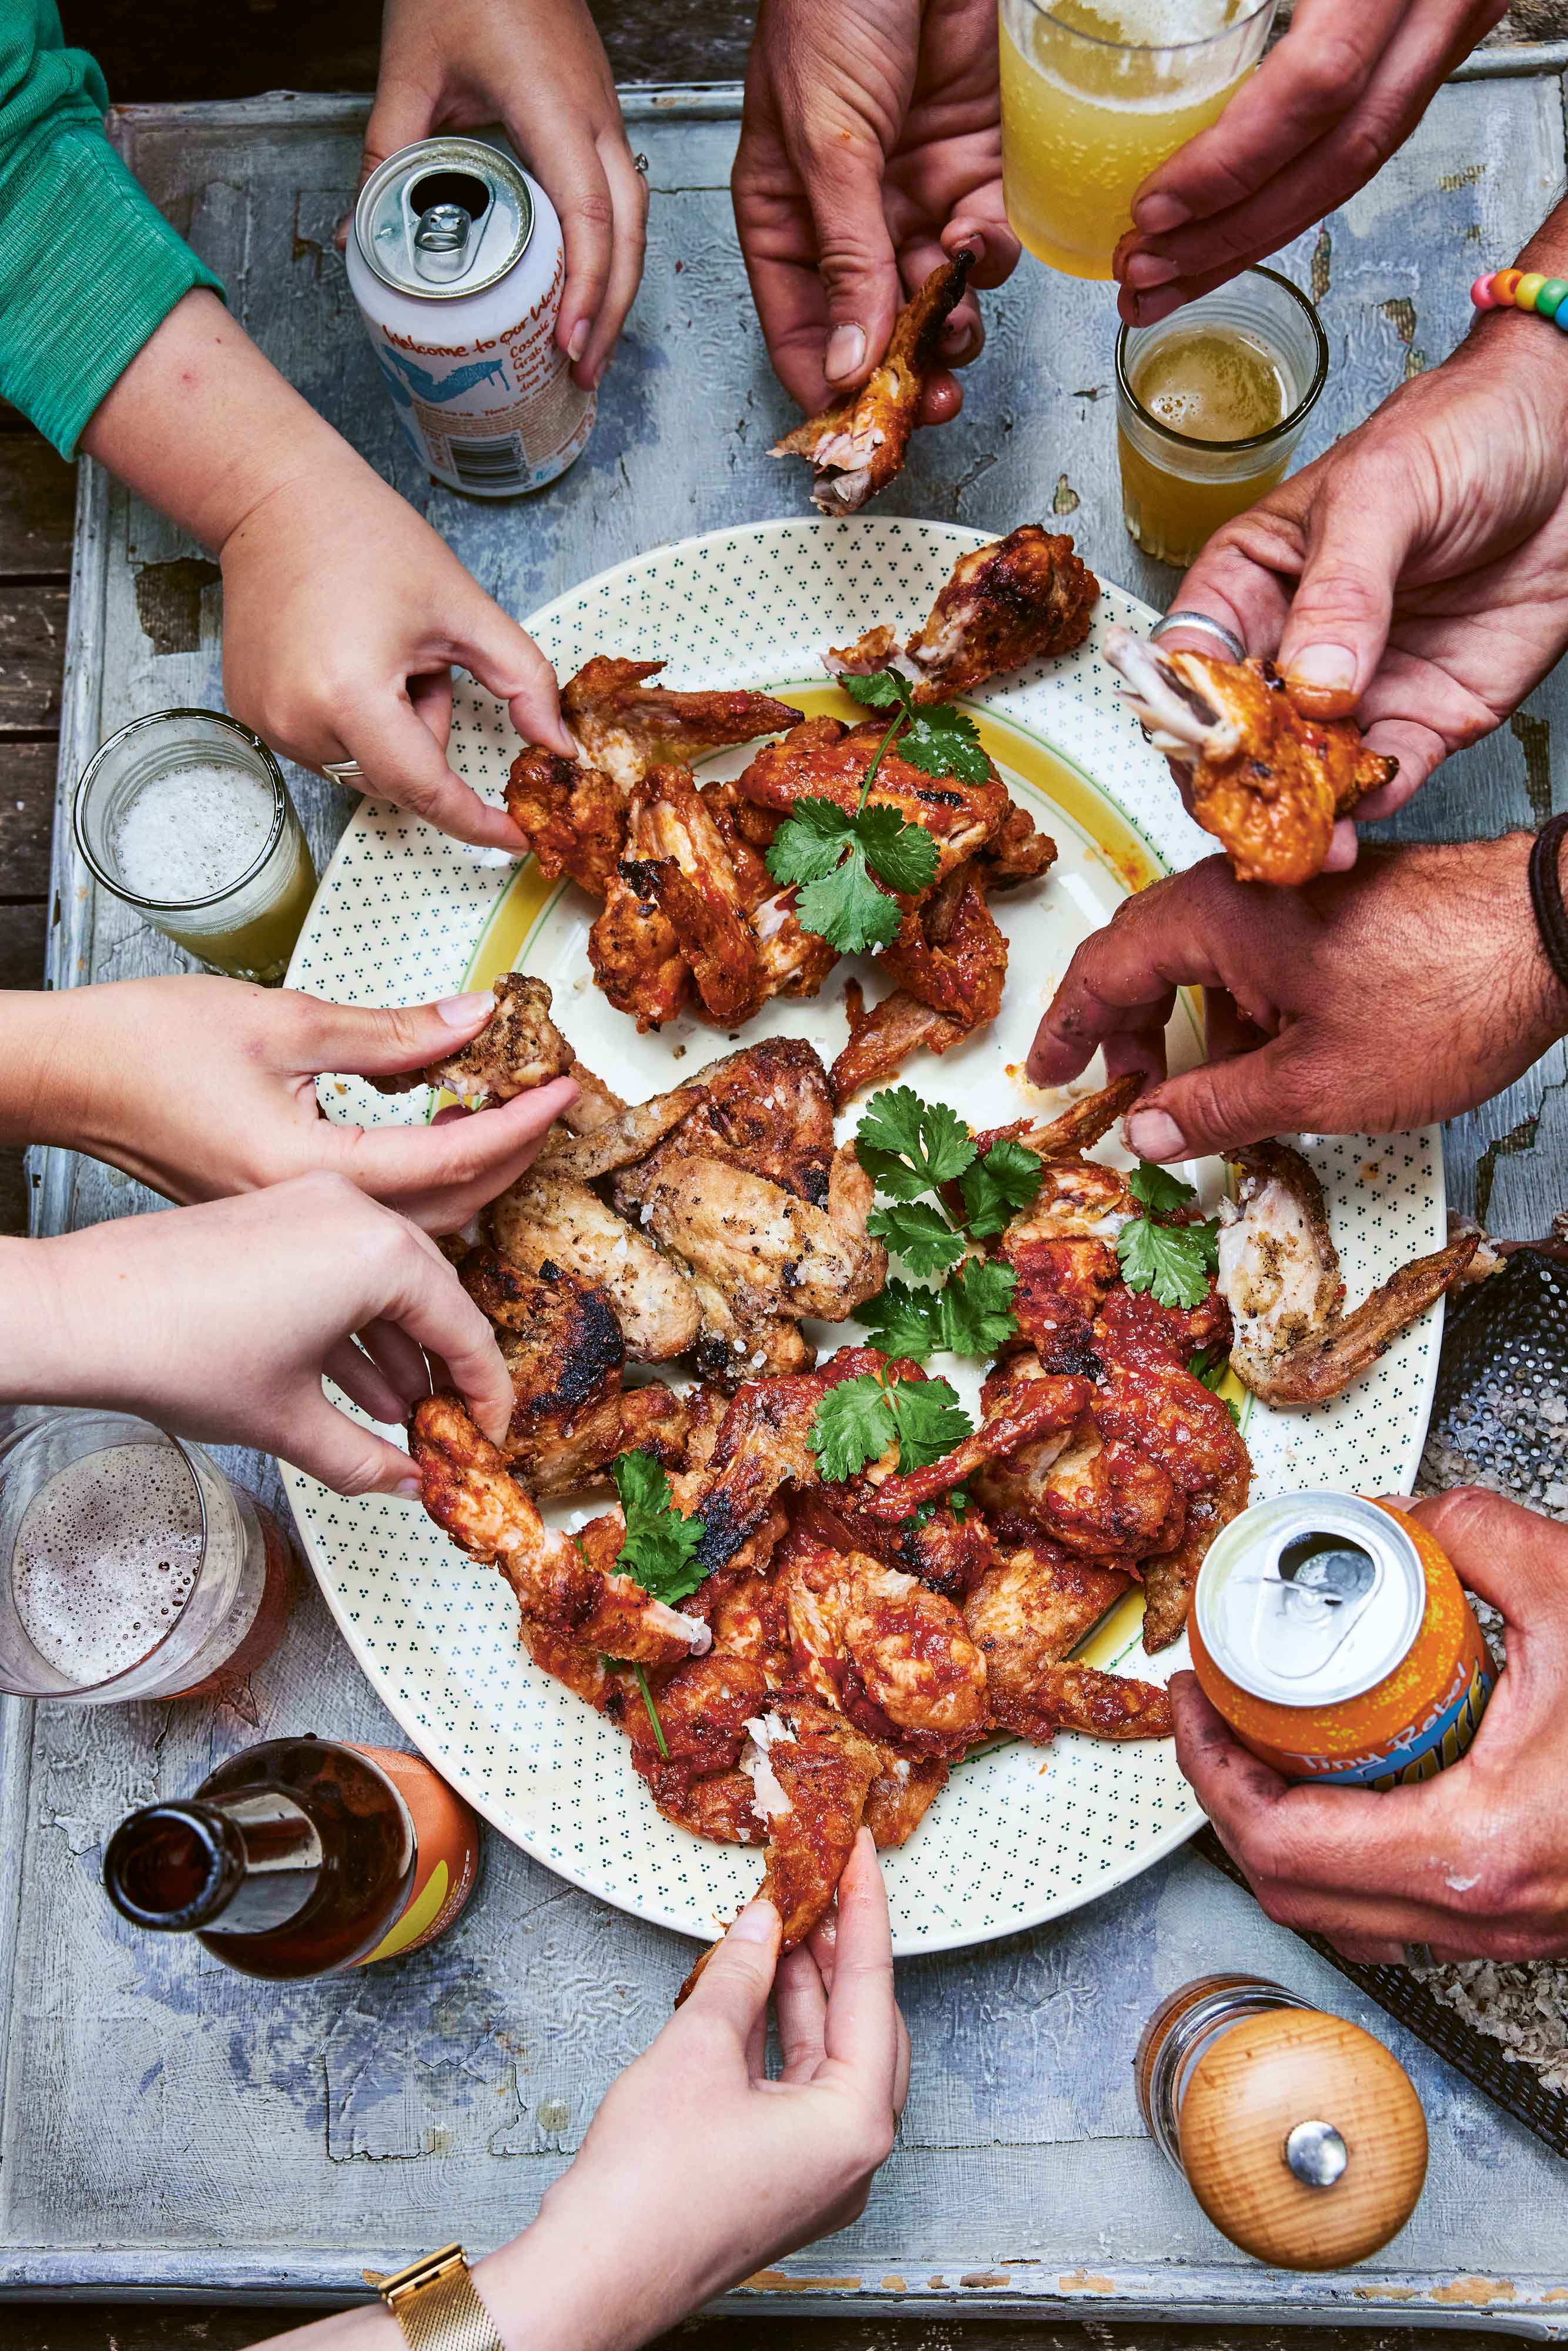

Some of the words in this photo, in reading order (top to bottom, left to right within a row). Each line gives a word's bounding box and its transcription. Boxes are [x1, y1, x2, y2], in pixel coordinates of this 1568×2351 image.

[382, 324, 469, 357] Welcome
[473, 338, 496, 353] to
[510, 319, 550, 359] Cosmic
[513, 346, 542, 370] Grab
[1283, 1751, 1387, 1778] Tiny
[1386, 1661, 1467, 1754] Rebel
